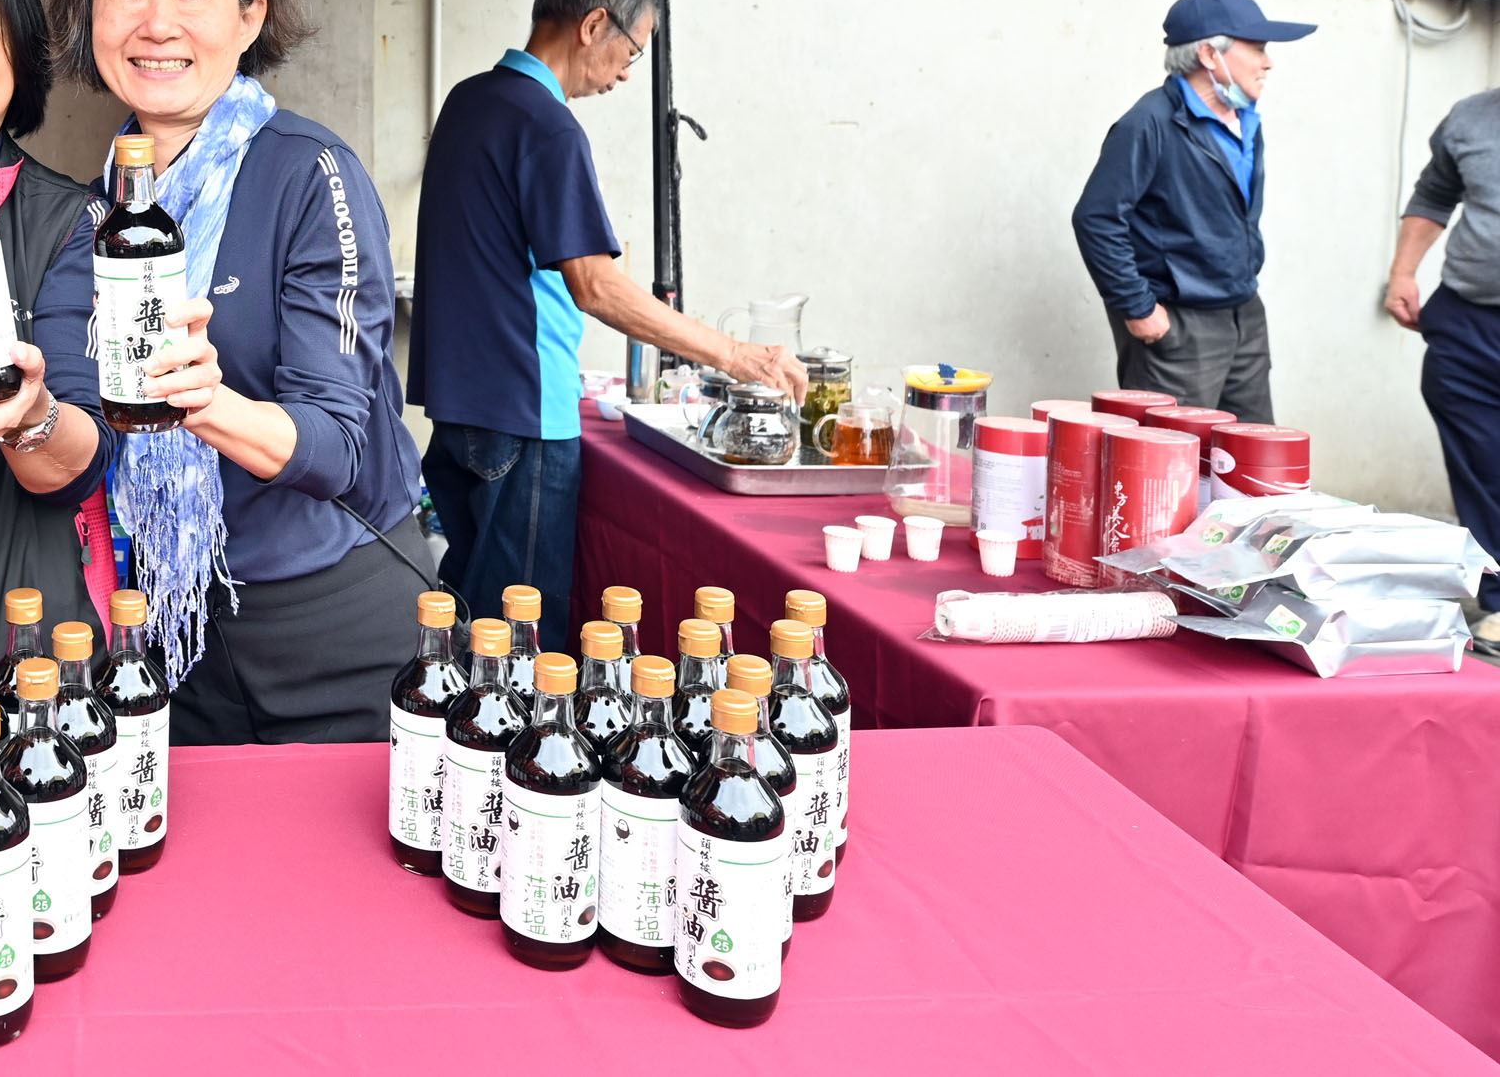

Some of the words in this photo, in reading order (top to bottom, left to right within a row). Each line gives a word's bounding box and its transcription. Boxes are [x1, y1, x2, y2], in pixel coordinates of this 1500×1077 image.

[328, 175, 358, 287] CROCODILE
[127, 297, 165, 361] 醬油
[121, 751, 158, 811] 醬油
[795, 791, 830, 853] 醬油
[554, 834, 593, 901] 醬油
[35, 901, 48, 910] 25
[683, 877, 723, 942] 醬油
[0, 957, 13, 968] 25
[714, 939, 730, 952] 25
